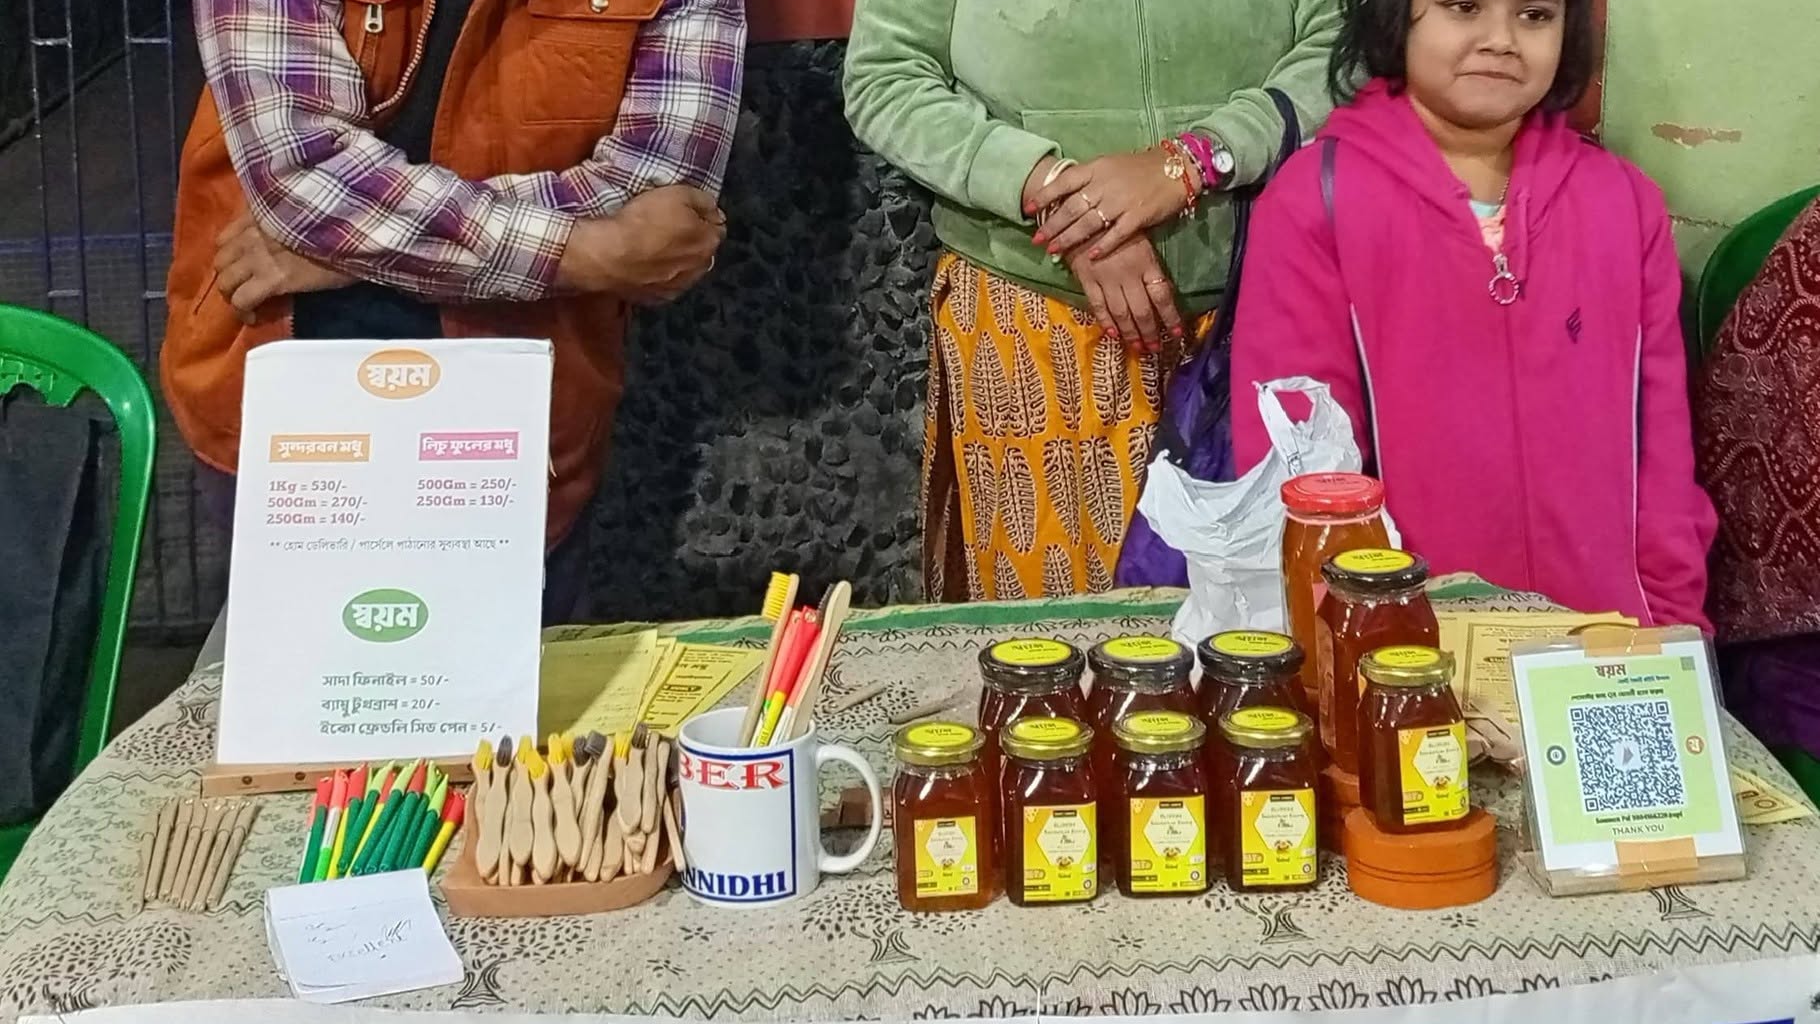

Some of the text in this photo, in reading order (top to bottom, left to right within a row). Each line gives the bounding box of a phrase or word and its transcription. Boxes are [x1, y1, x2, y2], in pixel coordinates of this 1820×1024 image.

[365, 362, 433, 391] স্বয়ম
[339, 439, 364, 458] মধু
[269, 480, 297, 494] 1Kg
[311, 479, 347, 493] 530/-
[417, 478, 467, 490] 500Gm
[481, 477, 517, 491] 250/-
[267, 497, 317, 508] 500Gm
[331, 495, 368, 509] 270/-
[416, 495, 466, 506] 250Gm
[480, 494, 515, 508] 130/-
[266, 513, 316, 524] 250Gm
[330, 511, 366, 526] 140/-
[351, 602, 420, 632] স্বয়ম
[321, 675, 351, 687] সাদা
[353, 671, 408, 687] ফিনাইল
[420, 675, 449, 686] 50/-
[411, 698, 441, 710] 20/-
[320, 720, 356, 734] ইকো
[410, 718, 437, 734] সিড
[440, 722, 468, 734] পেন
[480, 721, 502, 733] 5/-
[1612, 823, 1665, 836] THANK YOU
